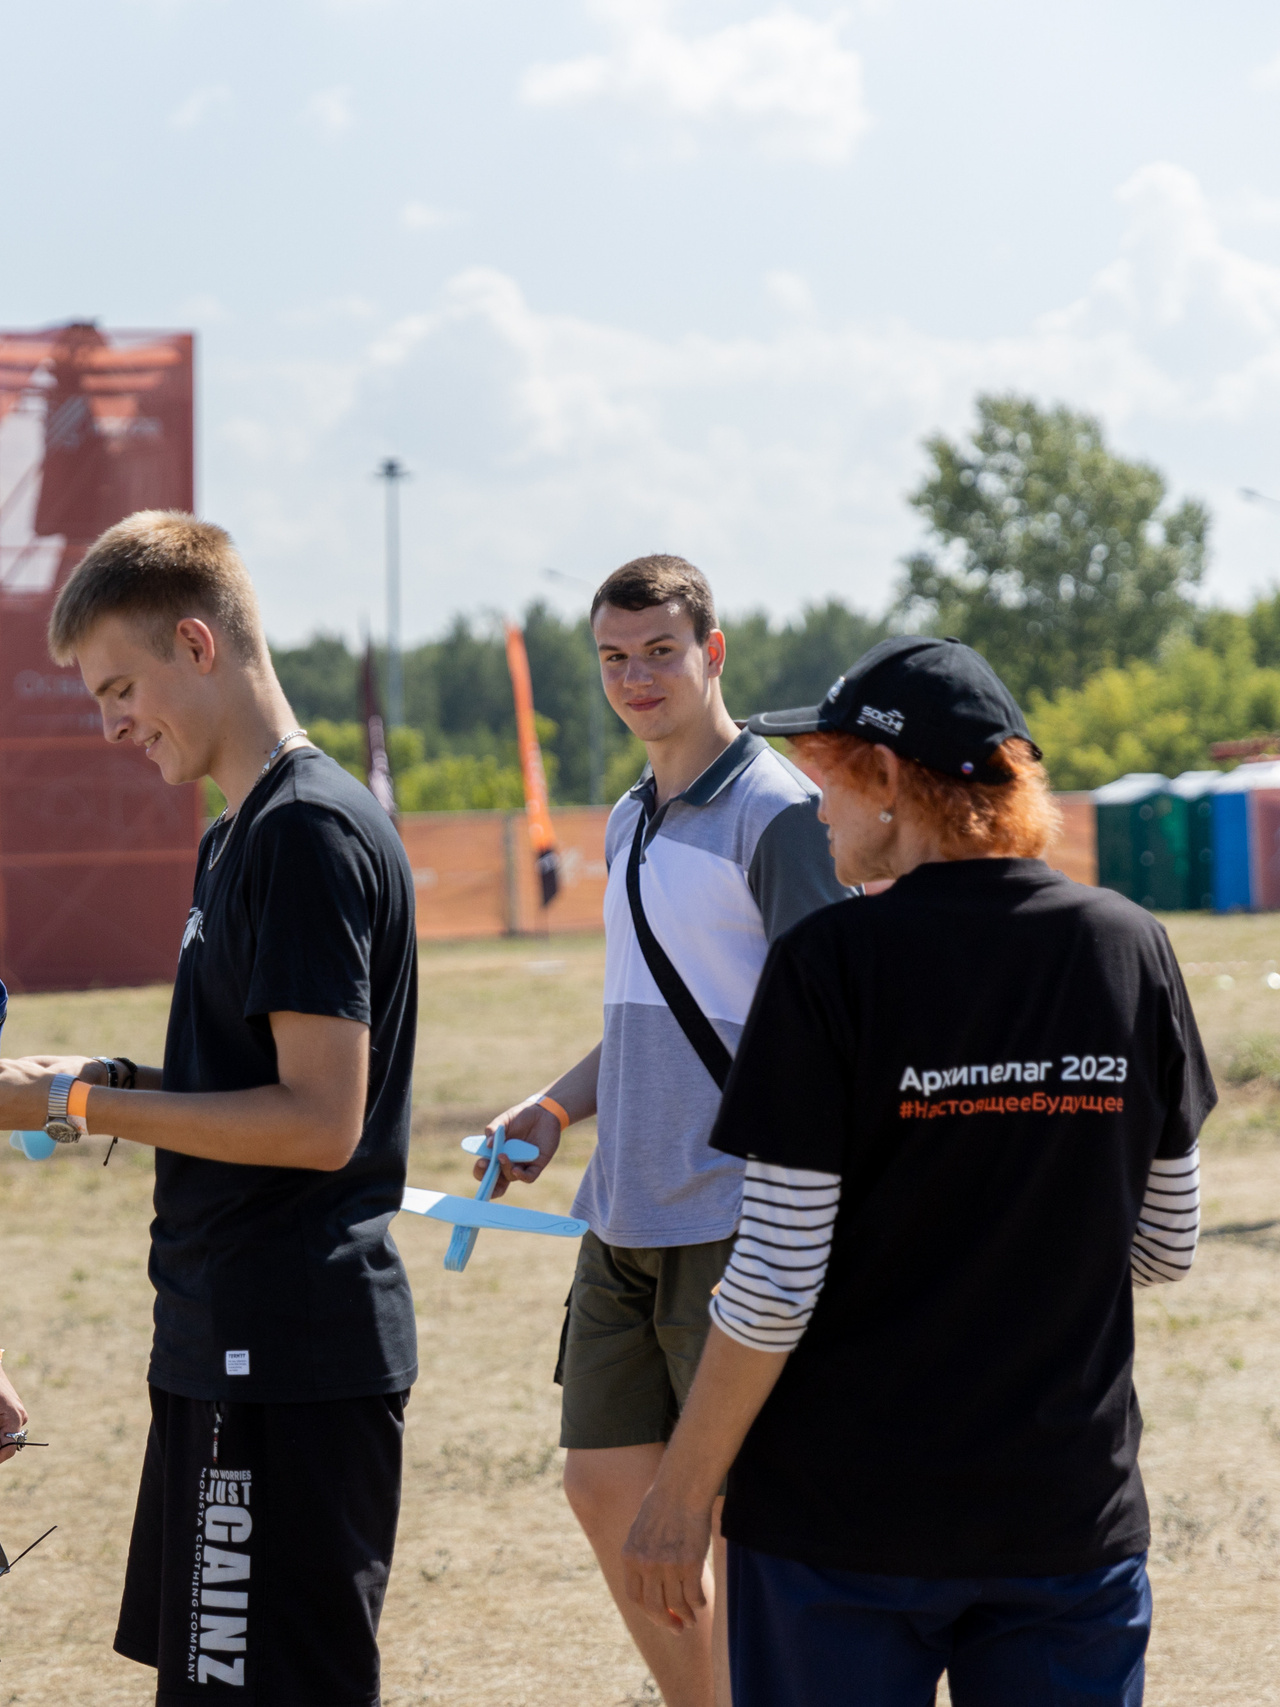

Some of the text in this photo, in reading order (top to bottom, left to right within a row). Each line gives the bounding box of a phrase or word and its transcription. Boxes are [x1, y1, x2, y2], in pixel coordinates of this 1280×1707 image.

[861, 705, 903, 731] SOCHI
[899, 1056, 1128, 1096] Архипелаг 2023
[899, 1092, 1124, 1118] #НастоящееБудущее
[210, 1469, 252, 1480] NO WORRIES
[206, 1480, 252, 1505] JUST
[187, 1467, 207, 1682] MONSTA CLOTHING COMPANY
[198, 1505, 253, 1686] GAINZ
